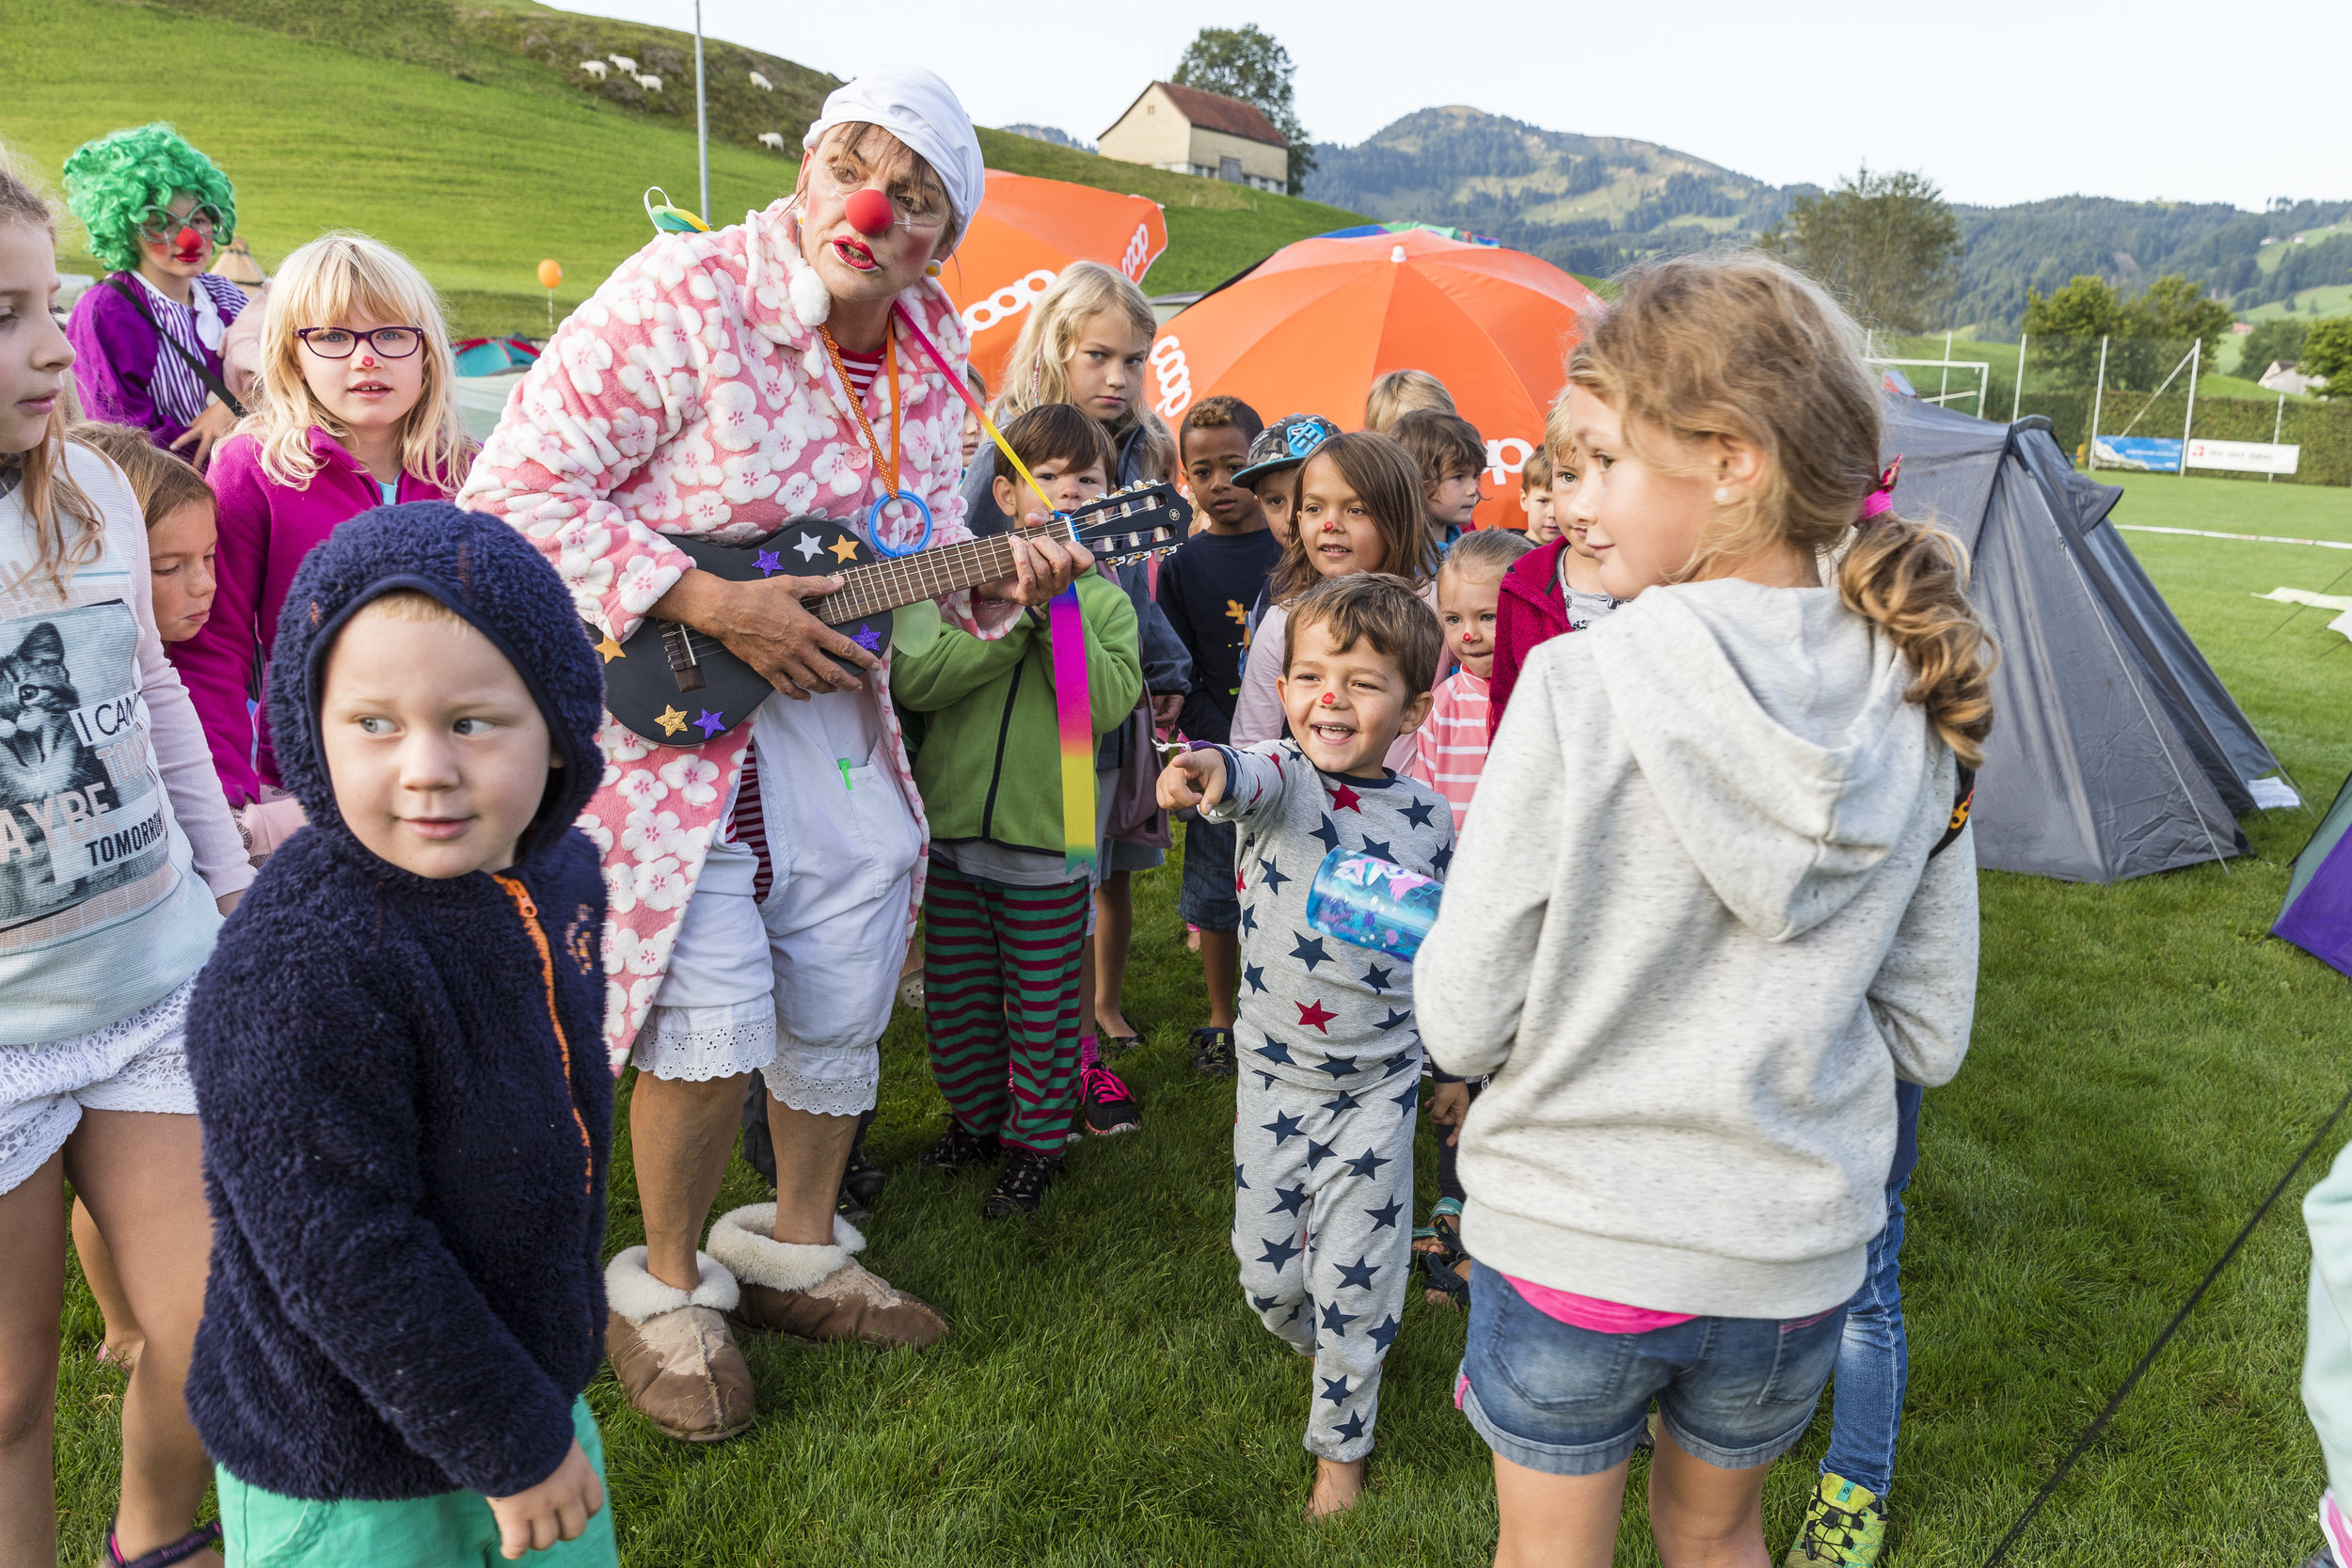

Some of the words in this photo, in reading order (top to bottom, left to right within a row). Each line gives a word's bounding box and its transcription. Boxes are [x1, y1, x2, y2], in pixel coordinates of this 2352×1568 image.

[961, 269, 1057, 340] oop
[1150, 334, 1193, 419] coop
[77, 712, 93, 742] I
[0, 782, 118, 864] AYBE
